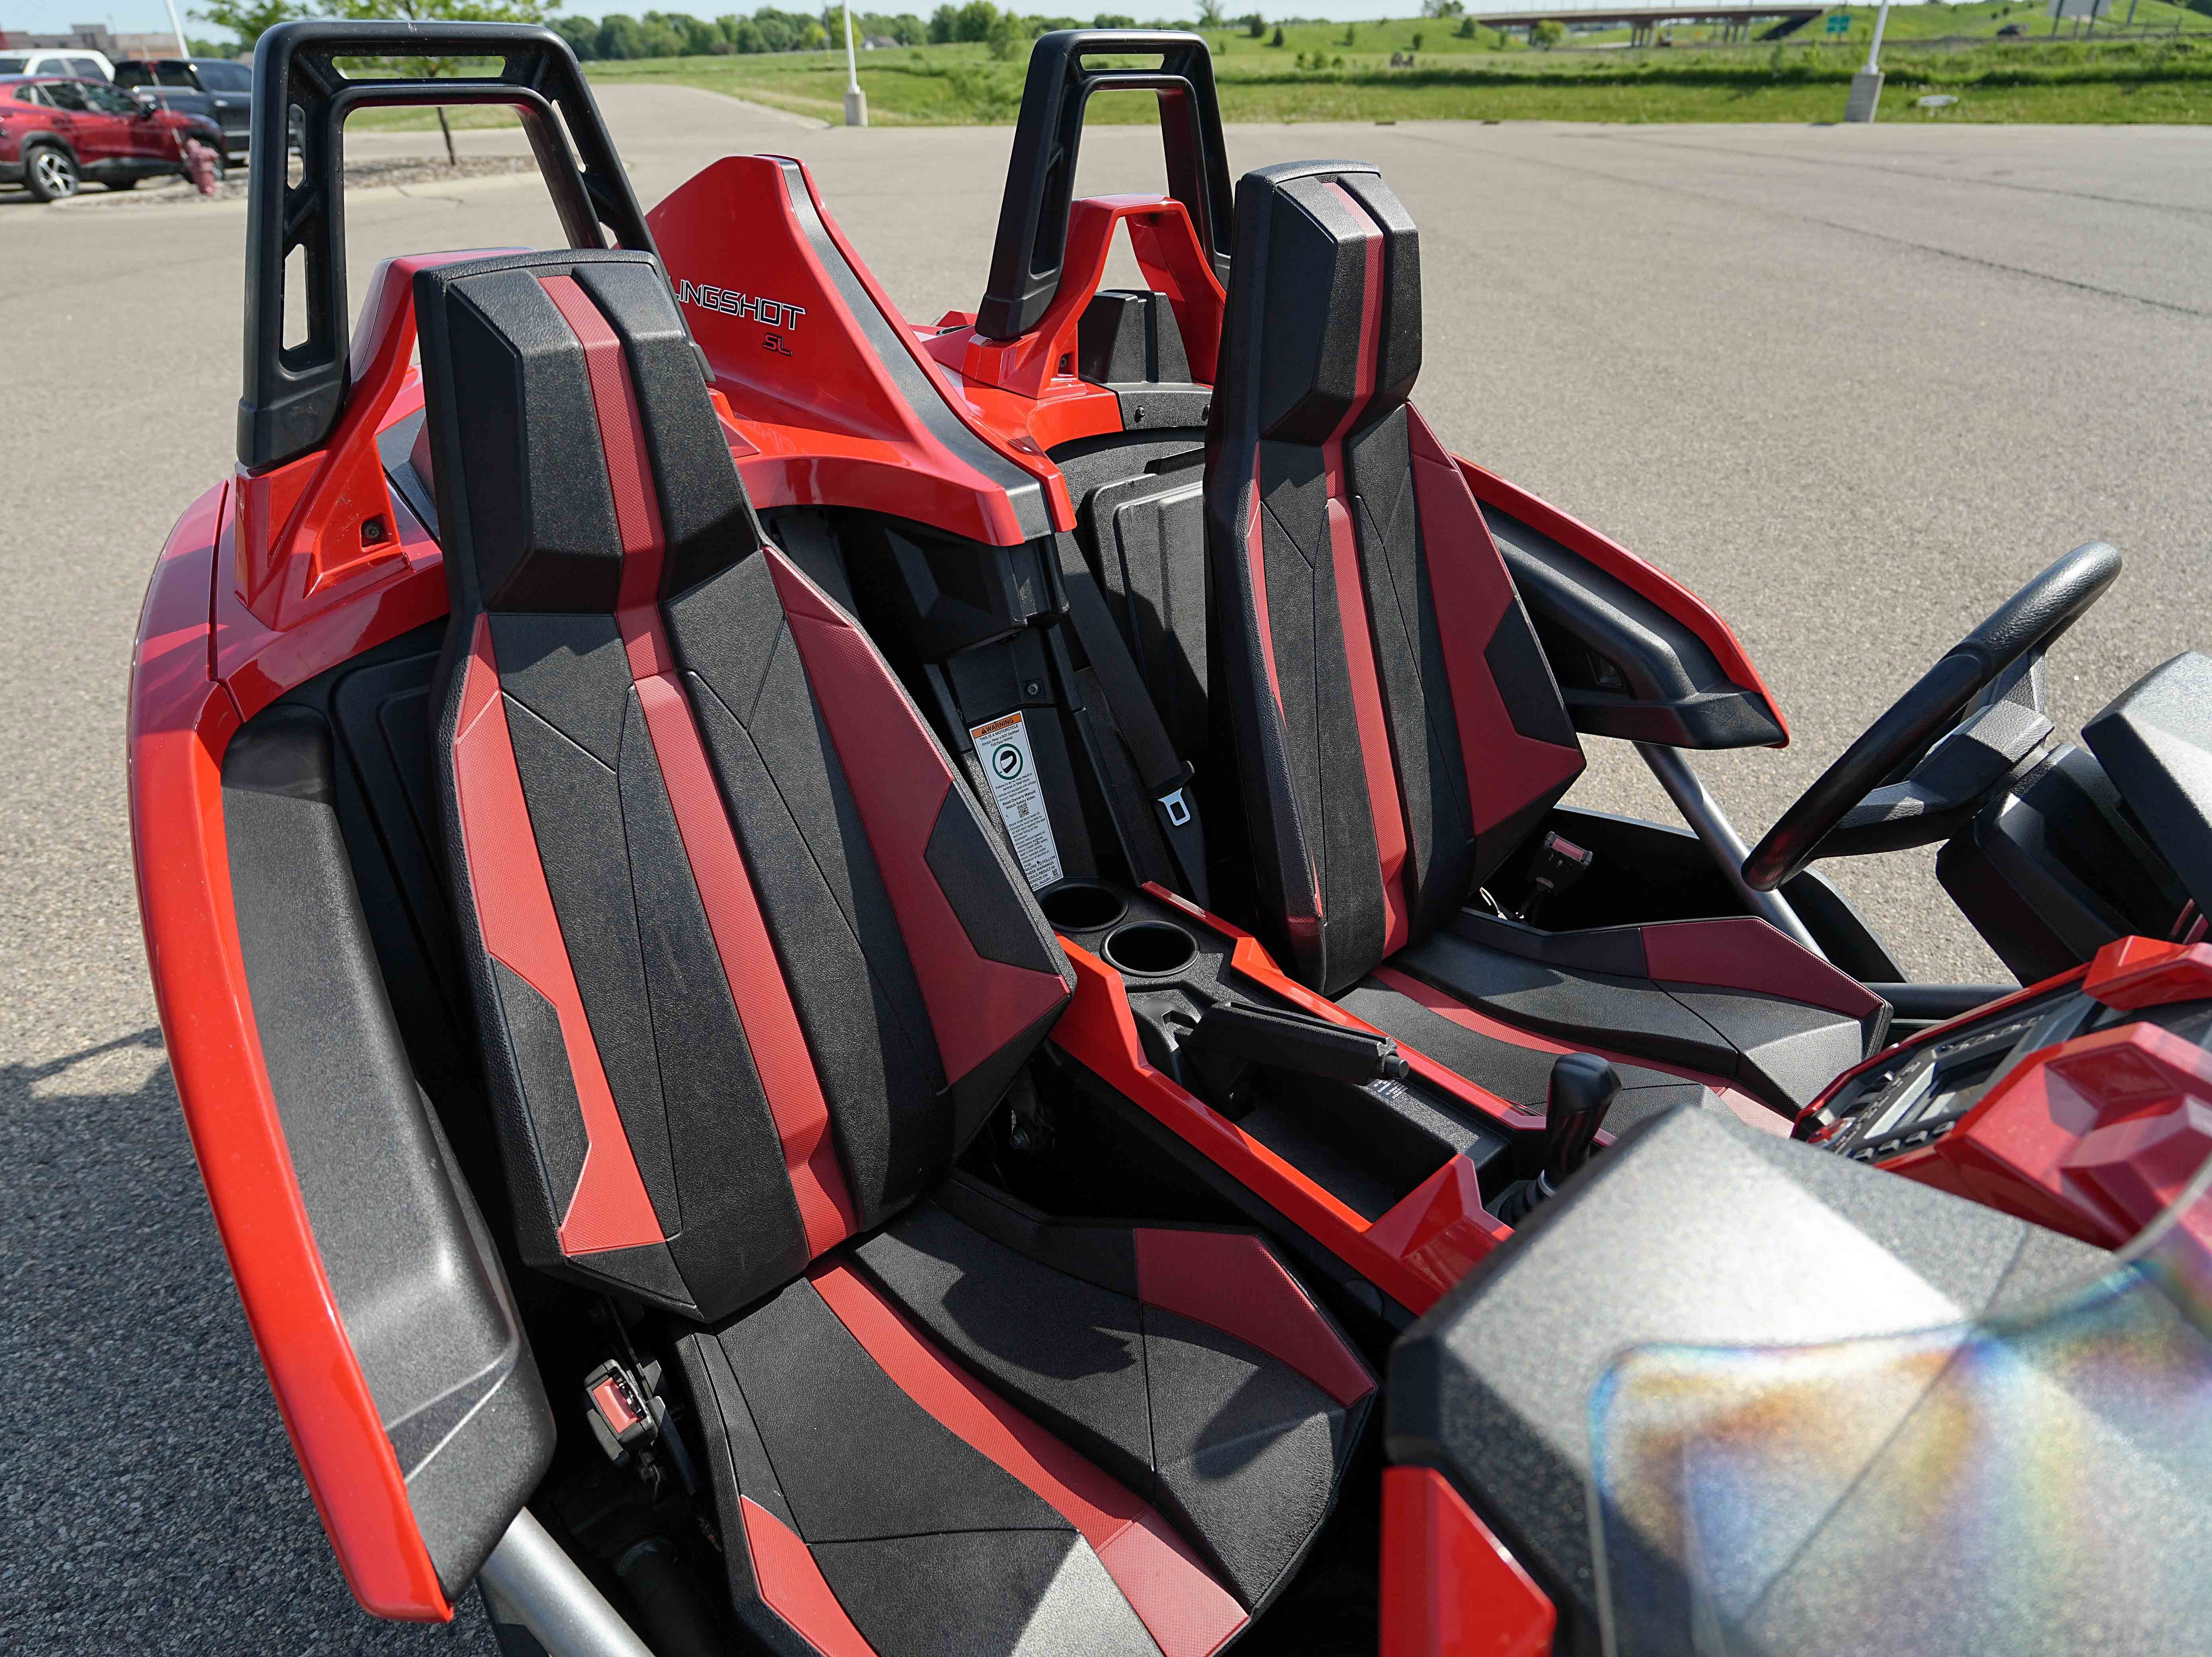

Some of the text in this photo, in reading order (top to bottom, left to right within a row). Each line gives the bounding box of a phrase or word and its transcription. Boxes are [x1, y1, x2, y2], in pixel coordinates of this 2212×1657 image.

[669, 275, 806, 330] INGSHOT
[763, 333, 792, 356] SL
[986, 718, 1014, 732] WARNING
[996, 724, 1019, 735] MOTORCYCLE
[1042, 855, 1055, 864] FOLLOW
[1036, 861, 1054, 871] WARNINGS
